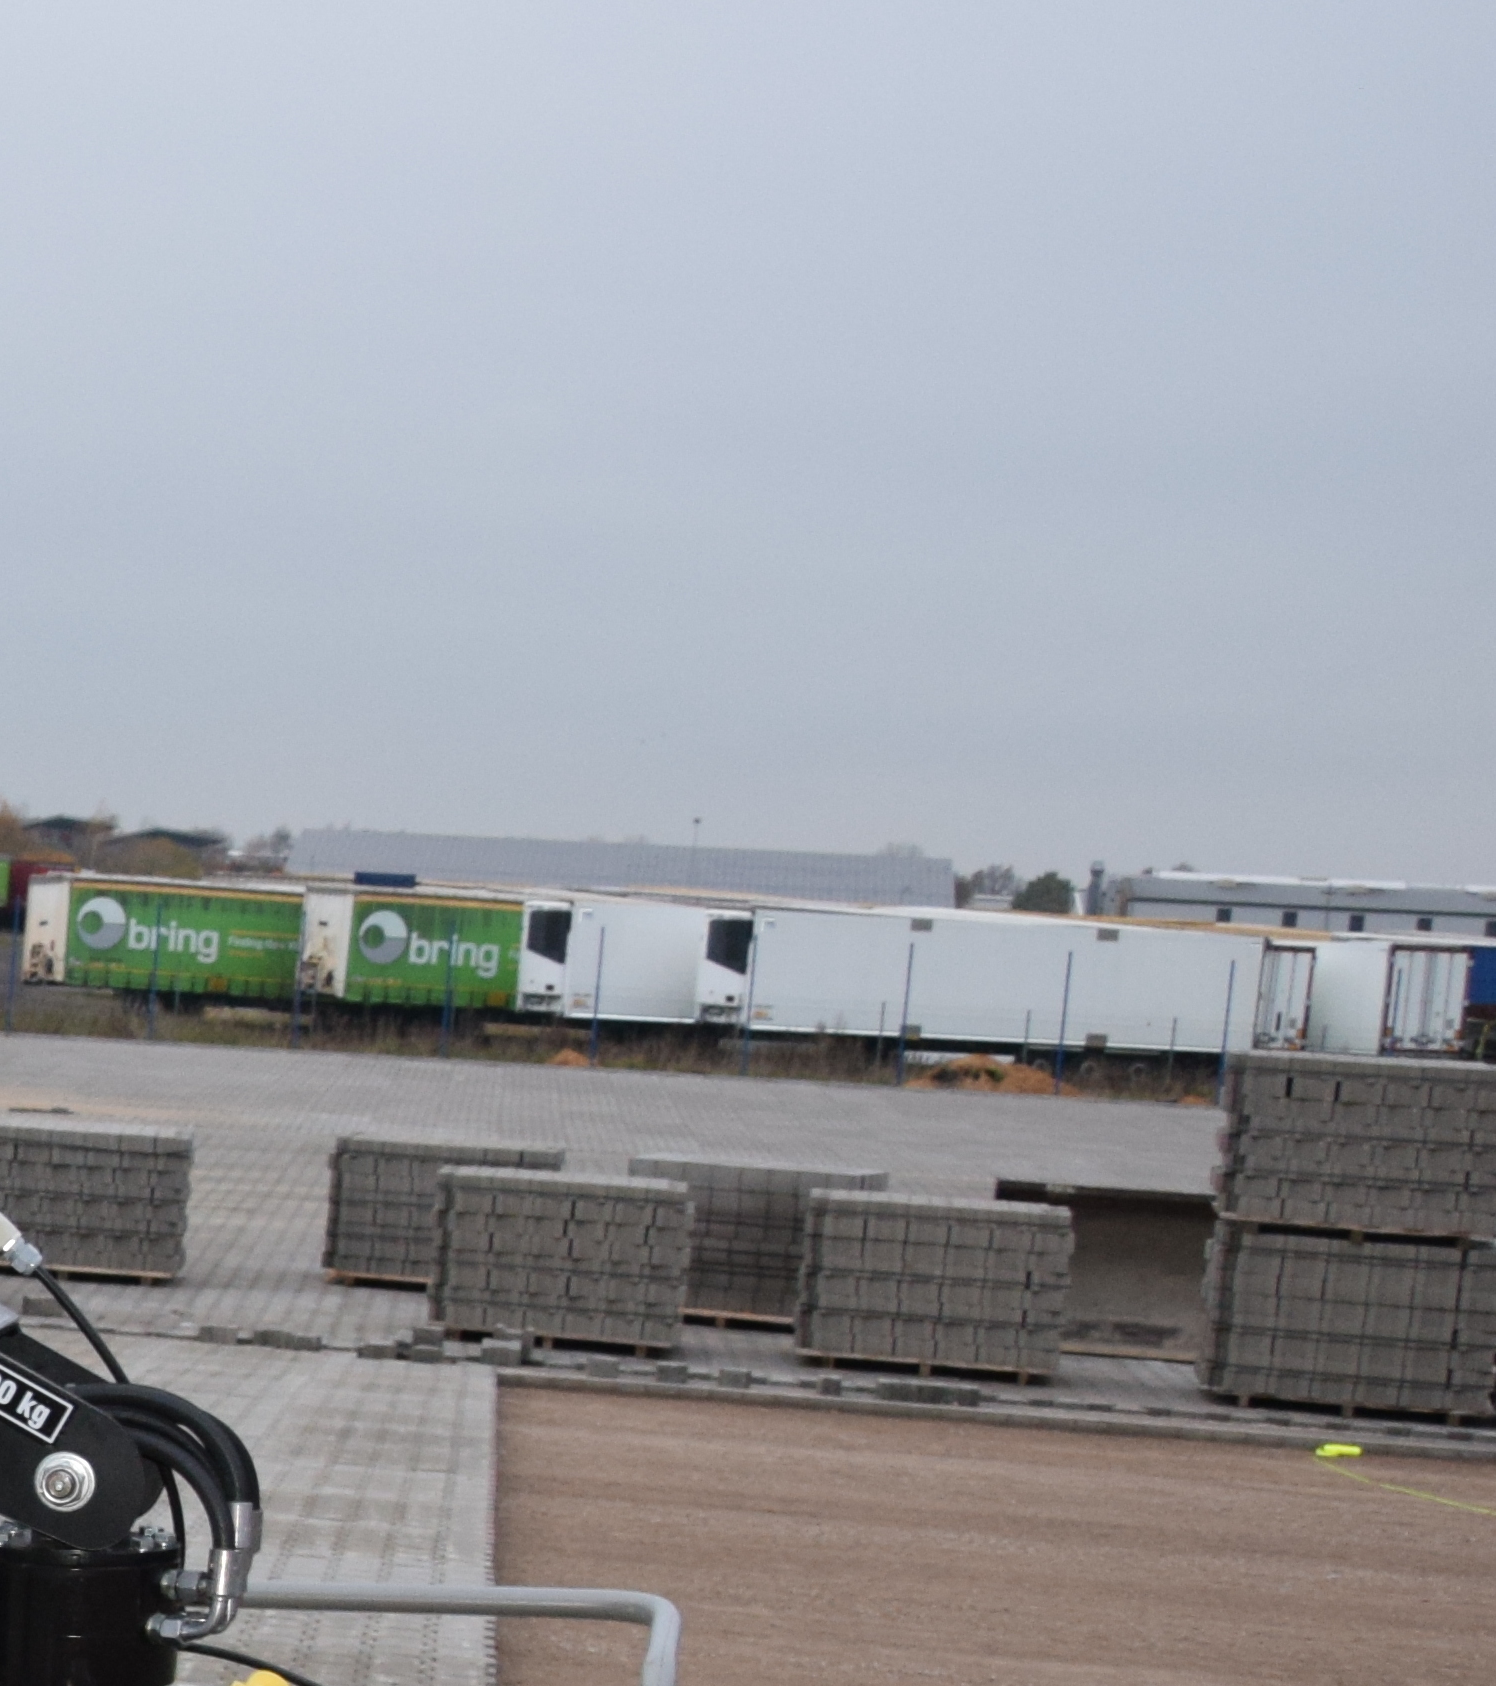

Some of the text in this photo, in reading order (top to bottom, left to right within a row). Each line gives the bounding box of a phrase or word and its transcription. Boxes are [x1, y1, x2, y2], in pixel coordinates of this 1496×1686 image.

[127, 917, 220, 964] bring
[408, 931, 500, 979] bring
[18, 1390, 52, 1431] kg
